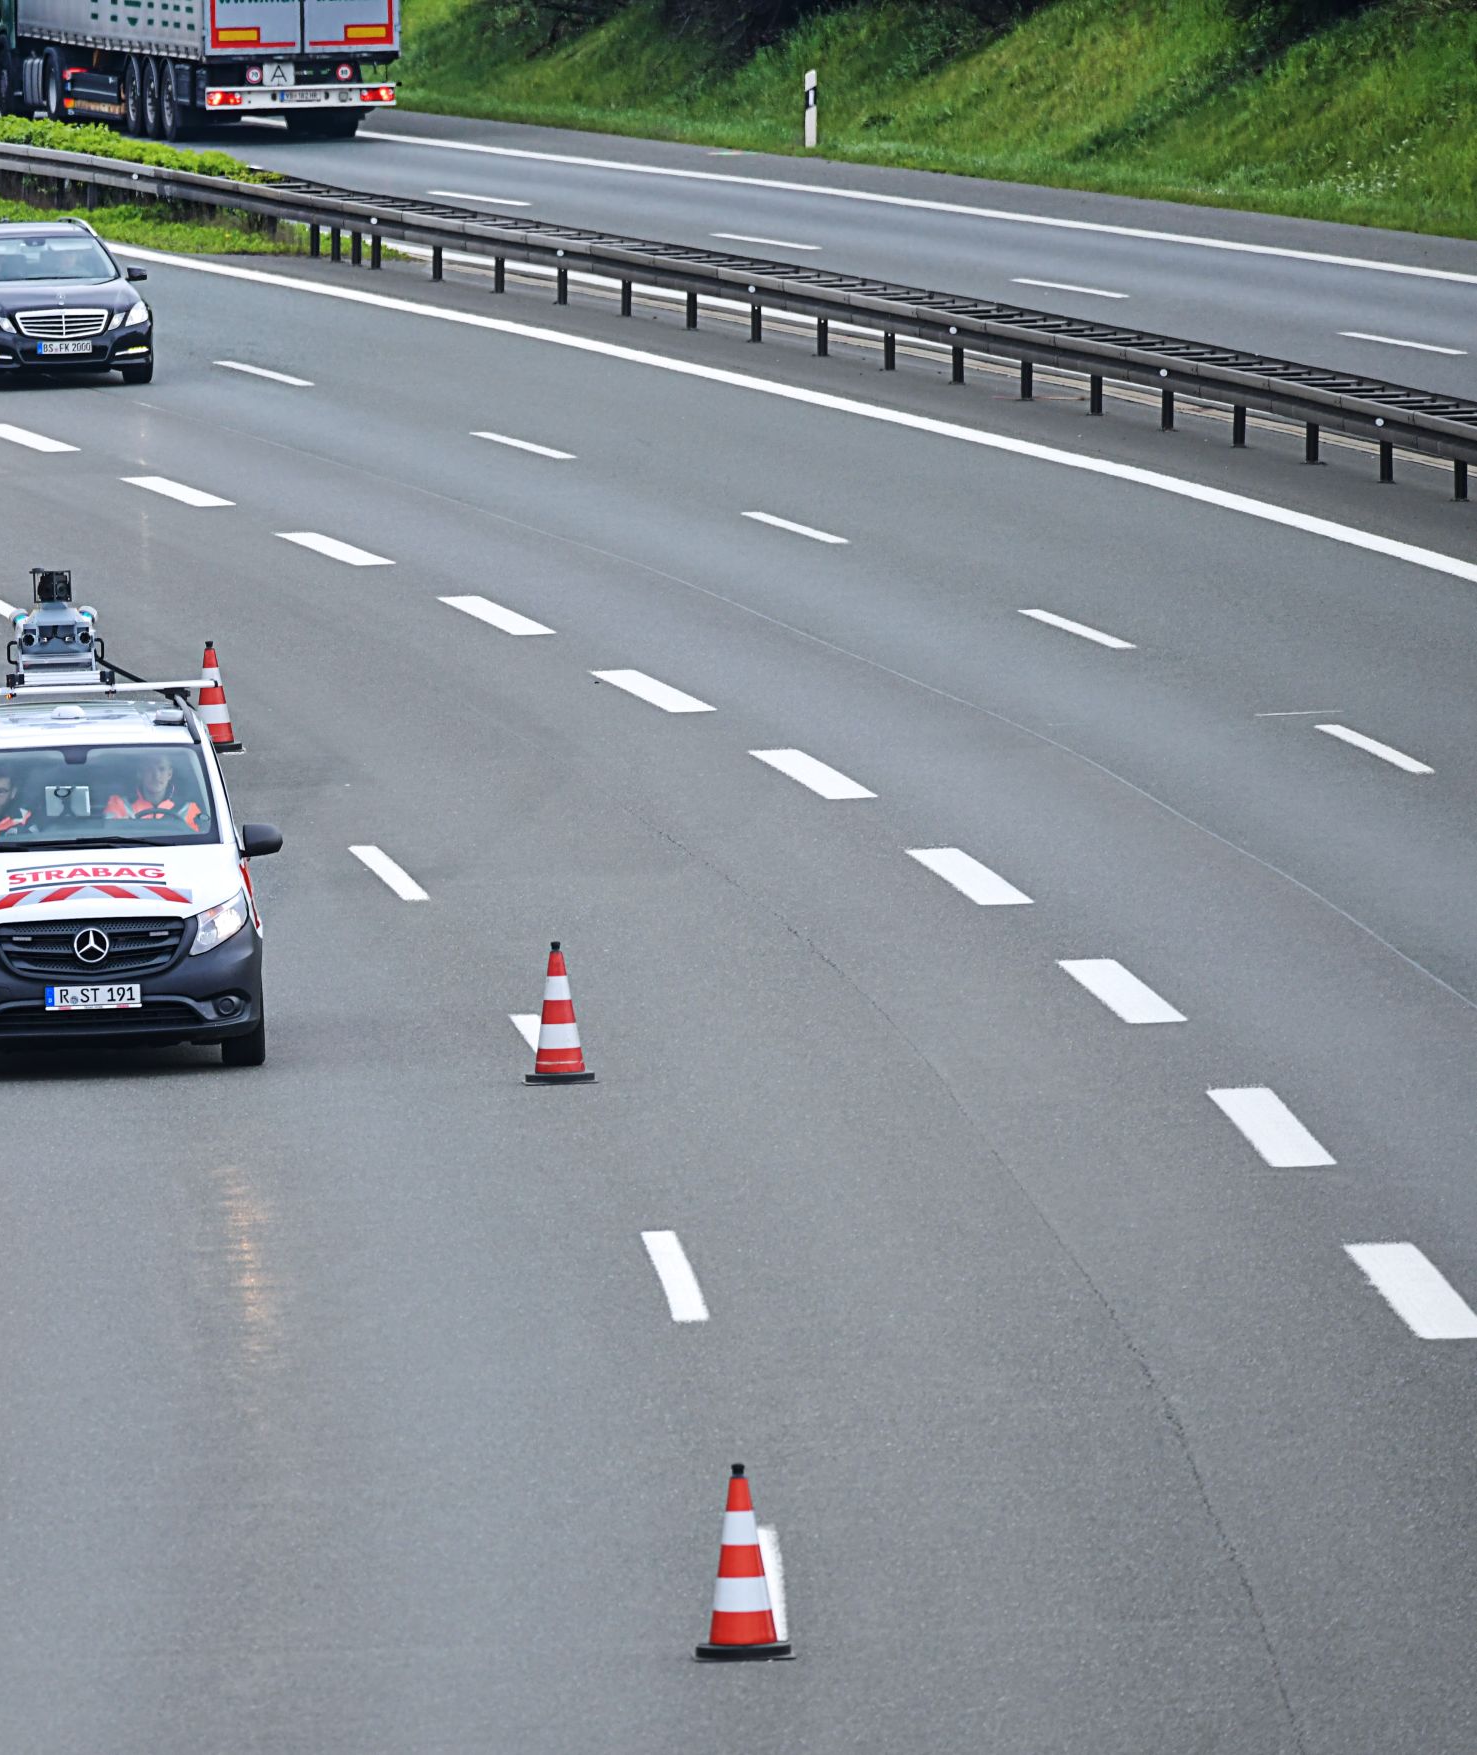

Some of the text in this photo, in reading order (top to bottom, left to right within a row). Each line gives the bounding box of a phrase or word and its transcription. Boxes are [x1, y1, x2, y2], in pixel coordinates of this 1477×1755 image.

[271, 65, 287, 82] A
[59, 344, 70, 352] FK
[8, 867, 166, 885] STRABAG
[59, 986, 135, 1004] R ST 191
